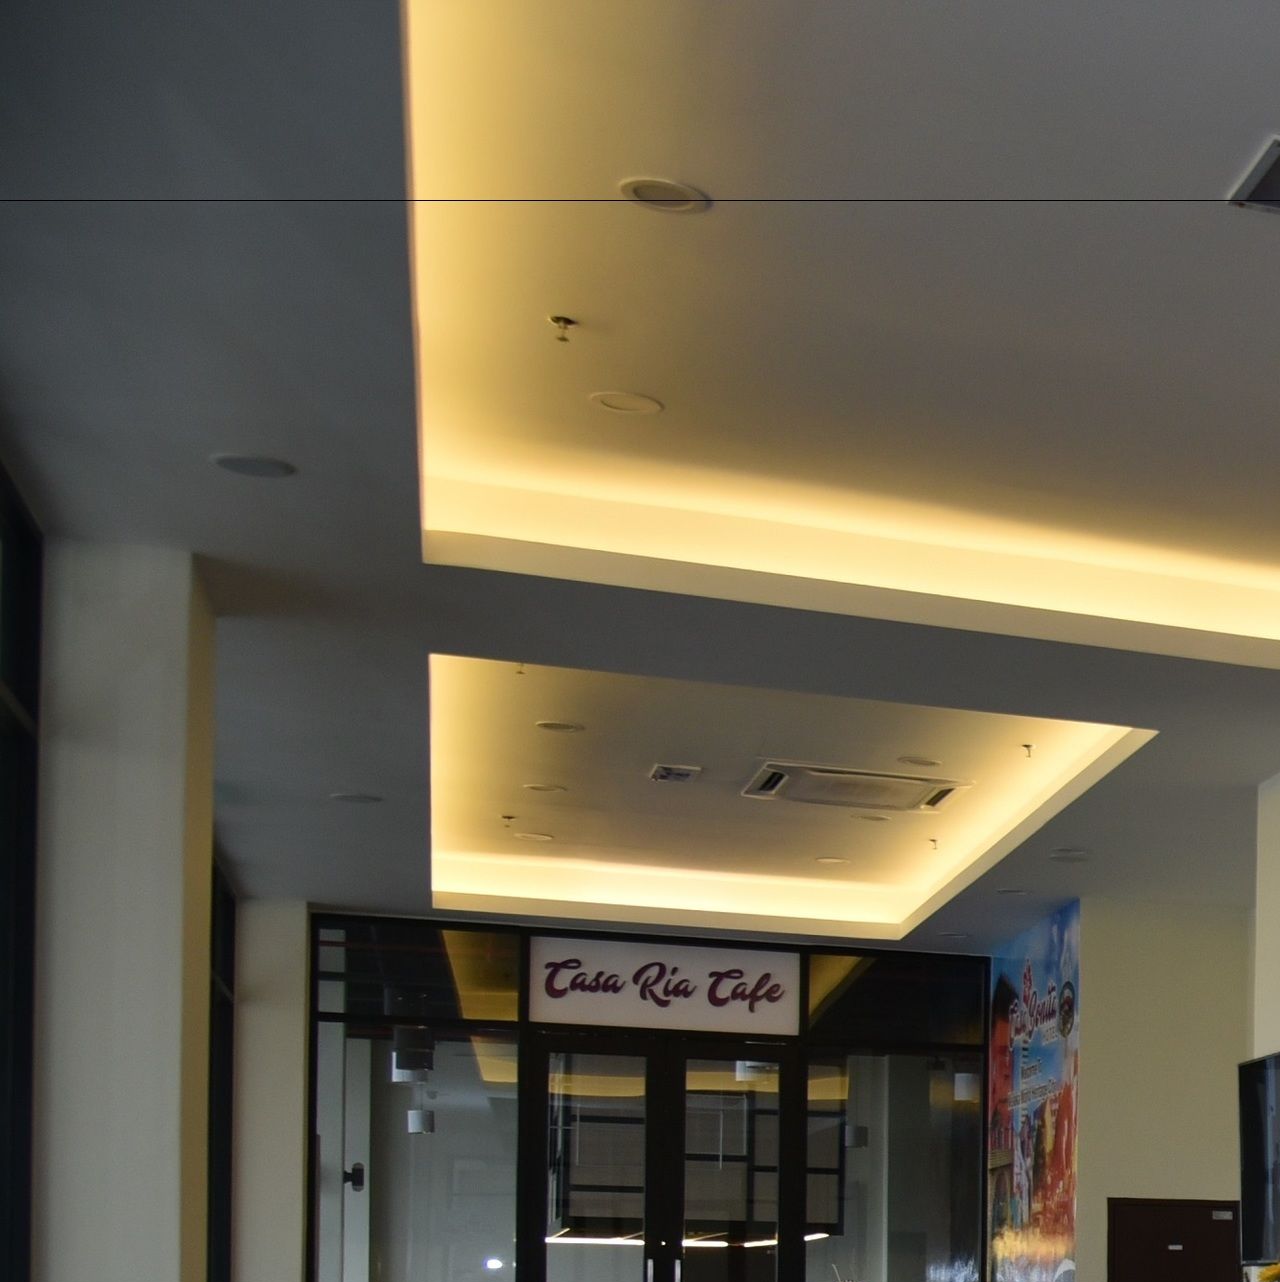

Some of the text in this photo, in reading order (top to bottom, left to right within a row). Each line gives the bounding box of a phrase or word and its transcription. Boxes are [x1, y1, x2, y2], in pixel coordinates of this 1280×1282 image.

[544, 958, 786, 1014] Casa Ria Cafe
